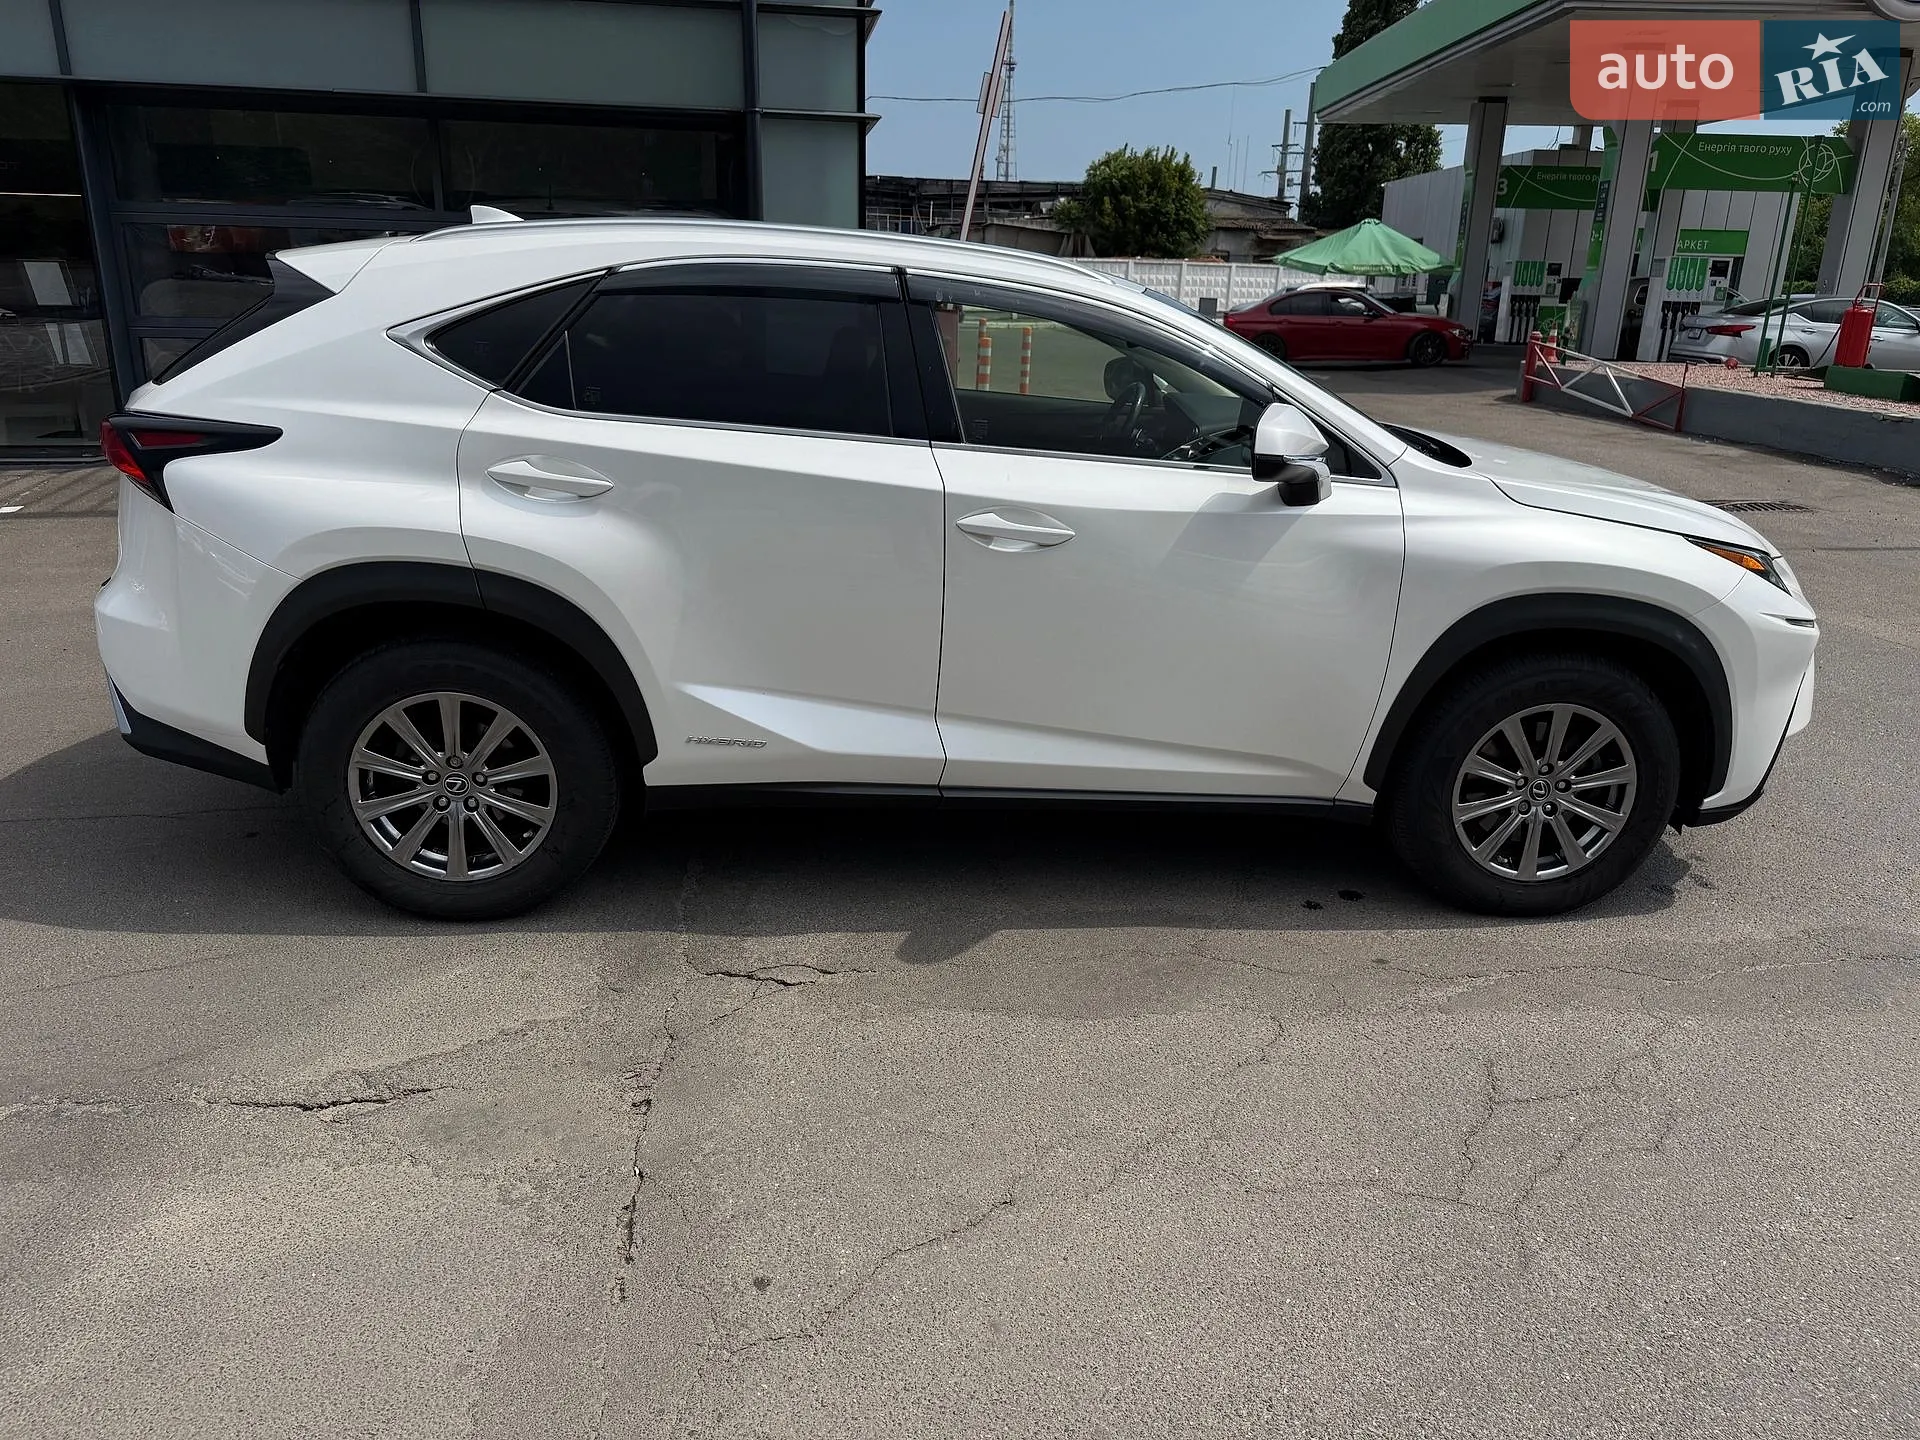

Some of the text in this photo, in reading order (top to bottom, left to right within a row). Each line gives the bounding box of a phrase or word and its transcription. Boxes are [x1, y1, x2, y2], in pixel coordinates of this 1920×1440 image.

[1698, 141, 1793, 156] Енергія твого руху
[1497, 178, 1508, 196] 3
[1677, 239, 1710, 250] АРКЕТ
[685, 735, 768, 749] HYBRID
